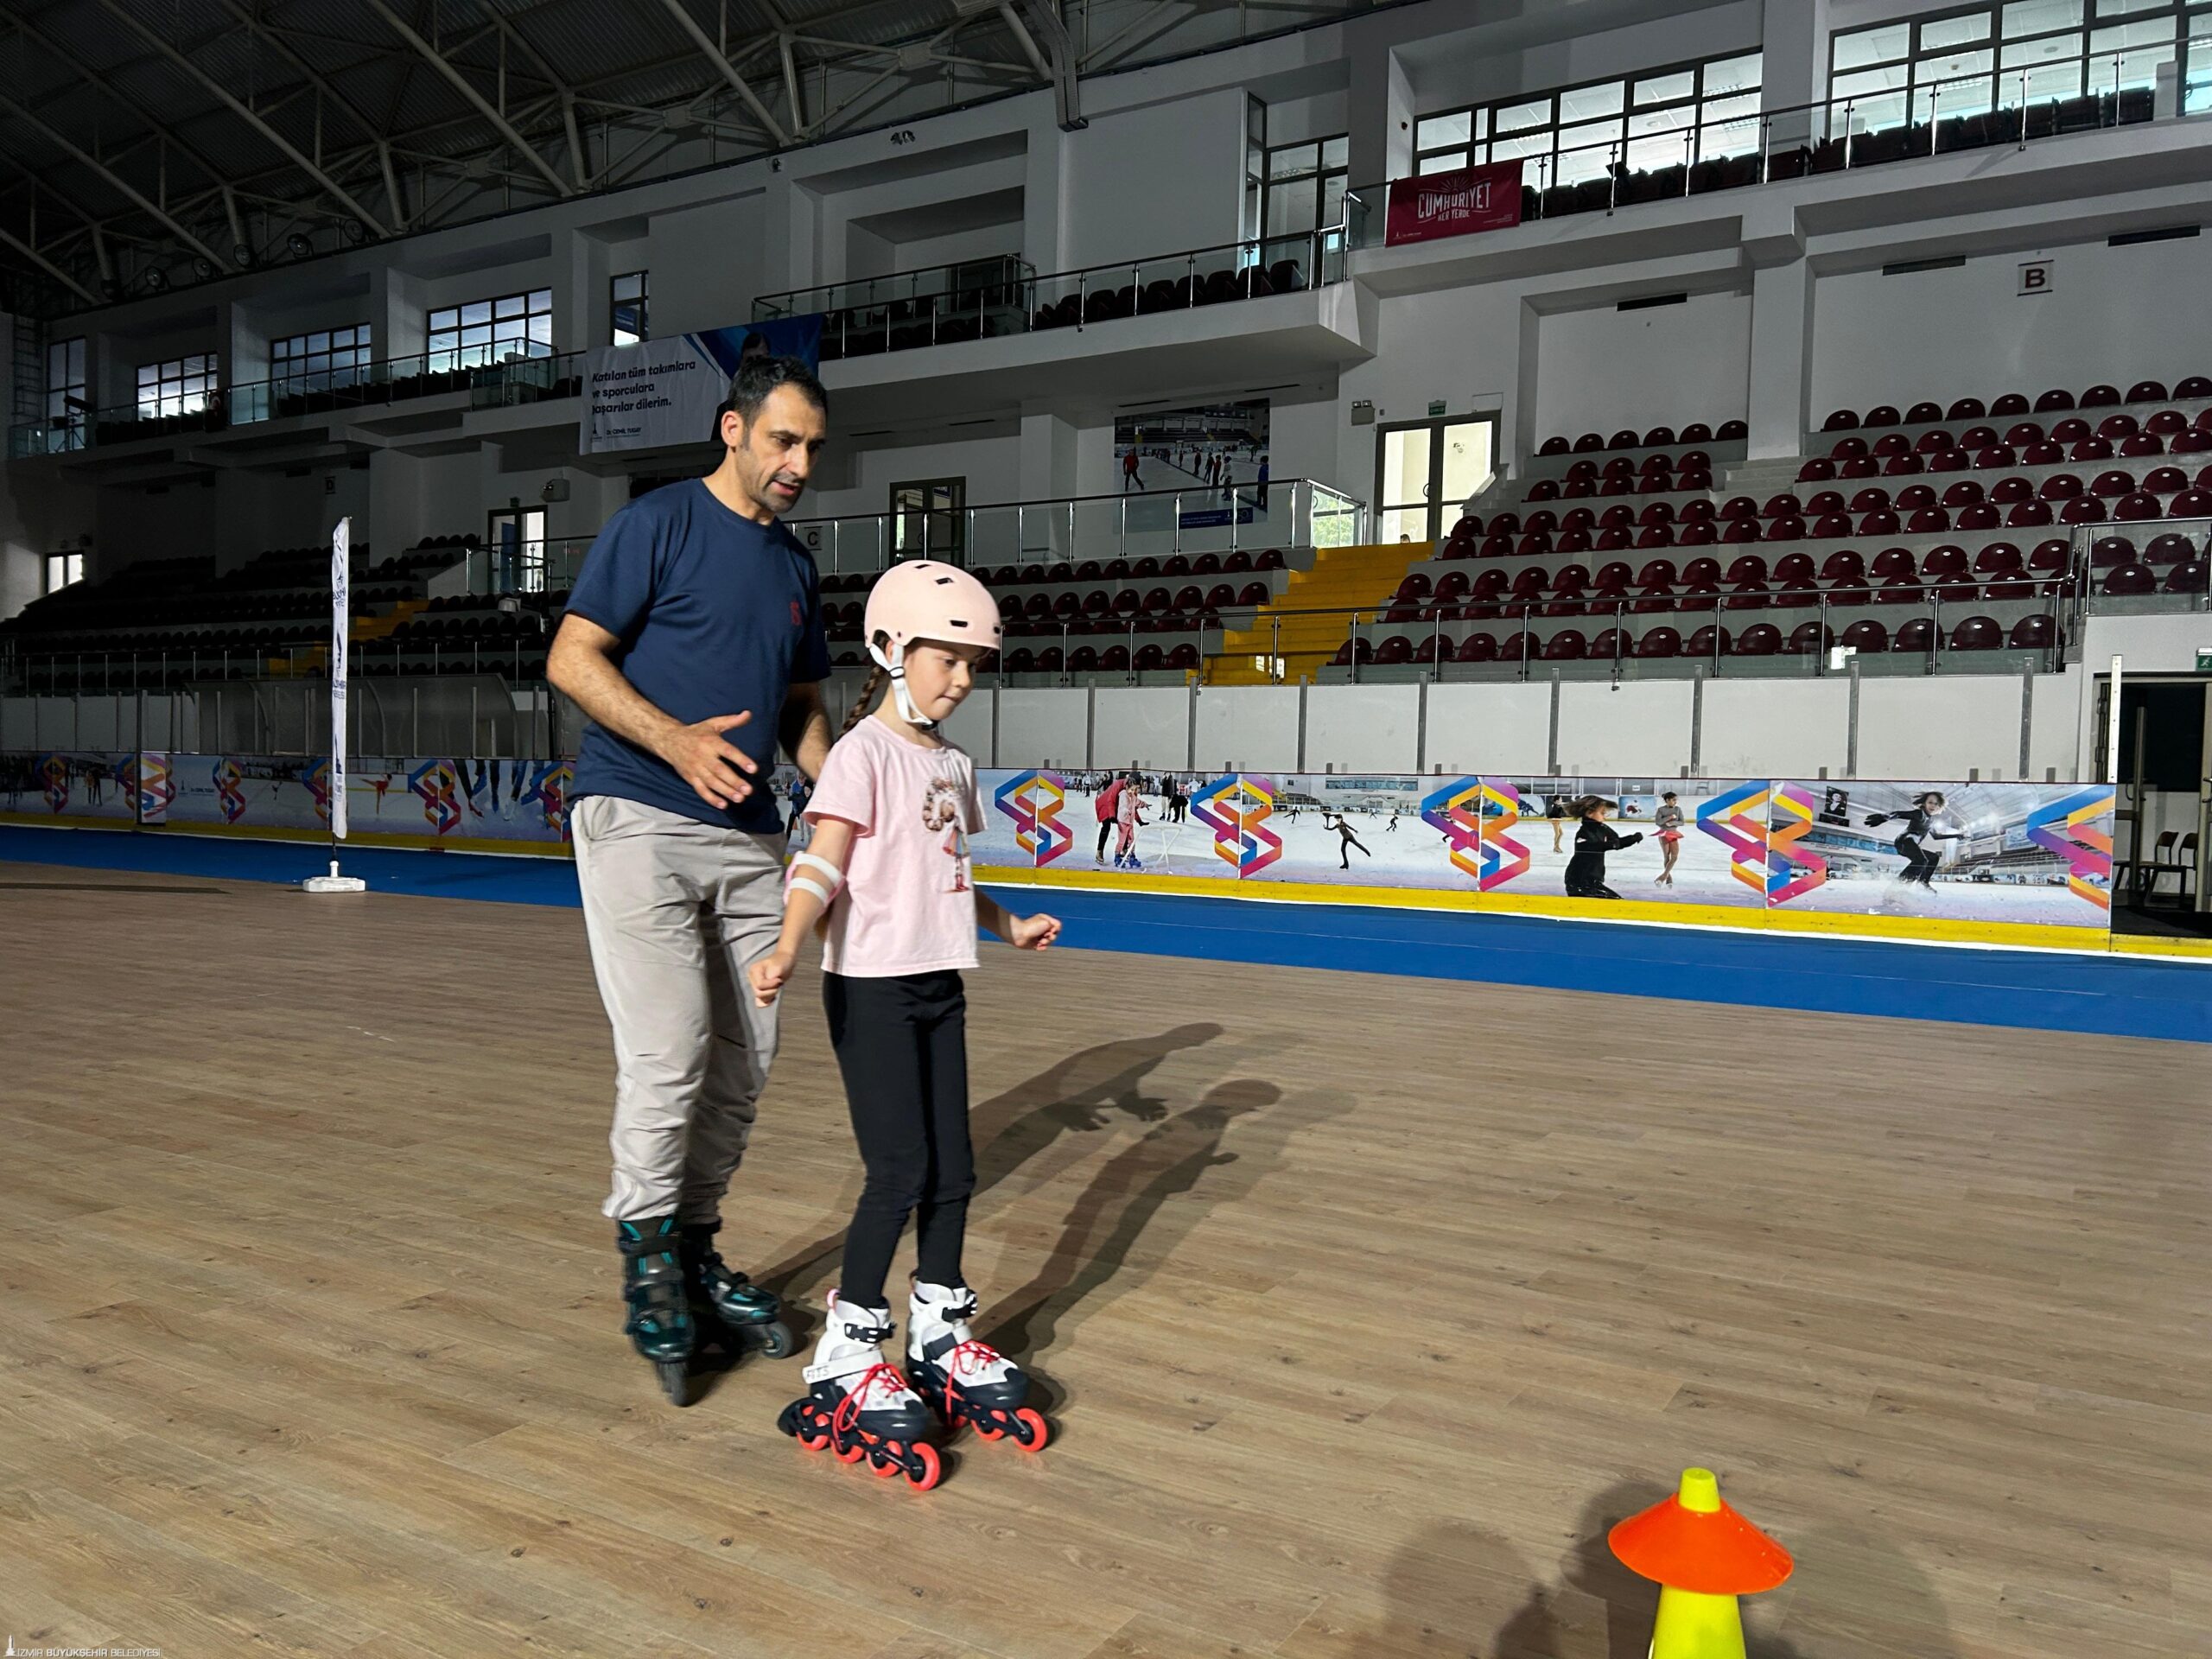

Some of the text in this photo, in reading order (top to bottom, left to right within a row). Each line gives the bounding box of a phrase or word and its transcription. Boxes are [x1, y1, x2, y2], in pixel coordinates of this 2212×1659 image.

[2025, 269, 2045, 289] B
[592, 360, 696, 383] Katılan tüm takımlara
[602, 383, 655, 399] sporculara
[636, 397, 672, 410] dilerim.
[808, 531, 818, 546] C
